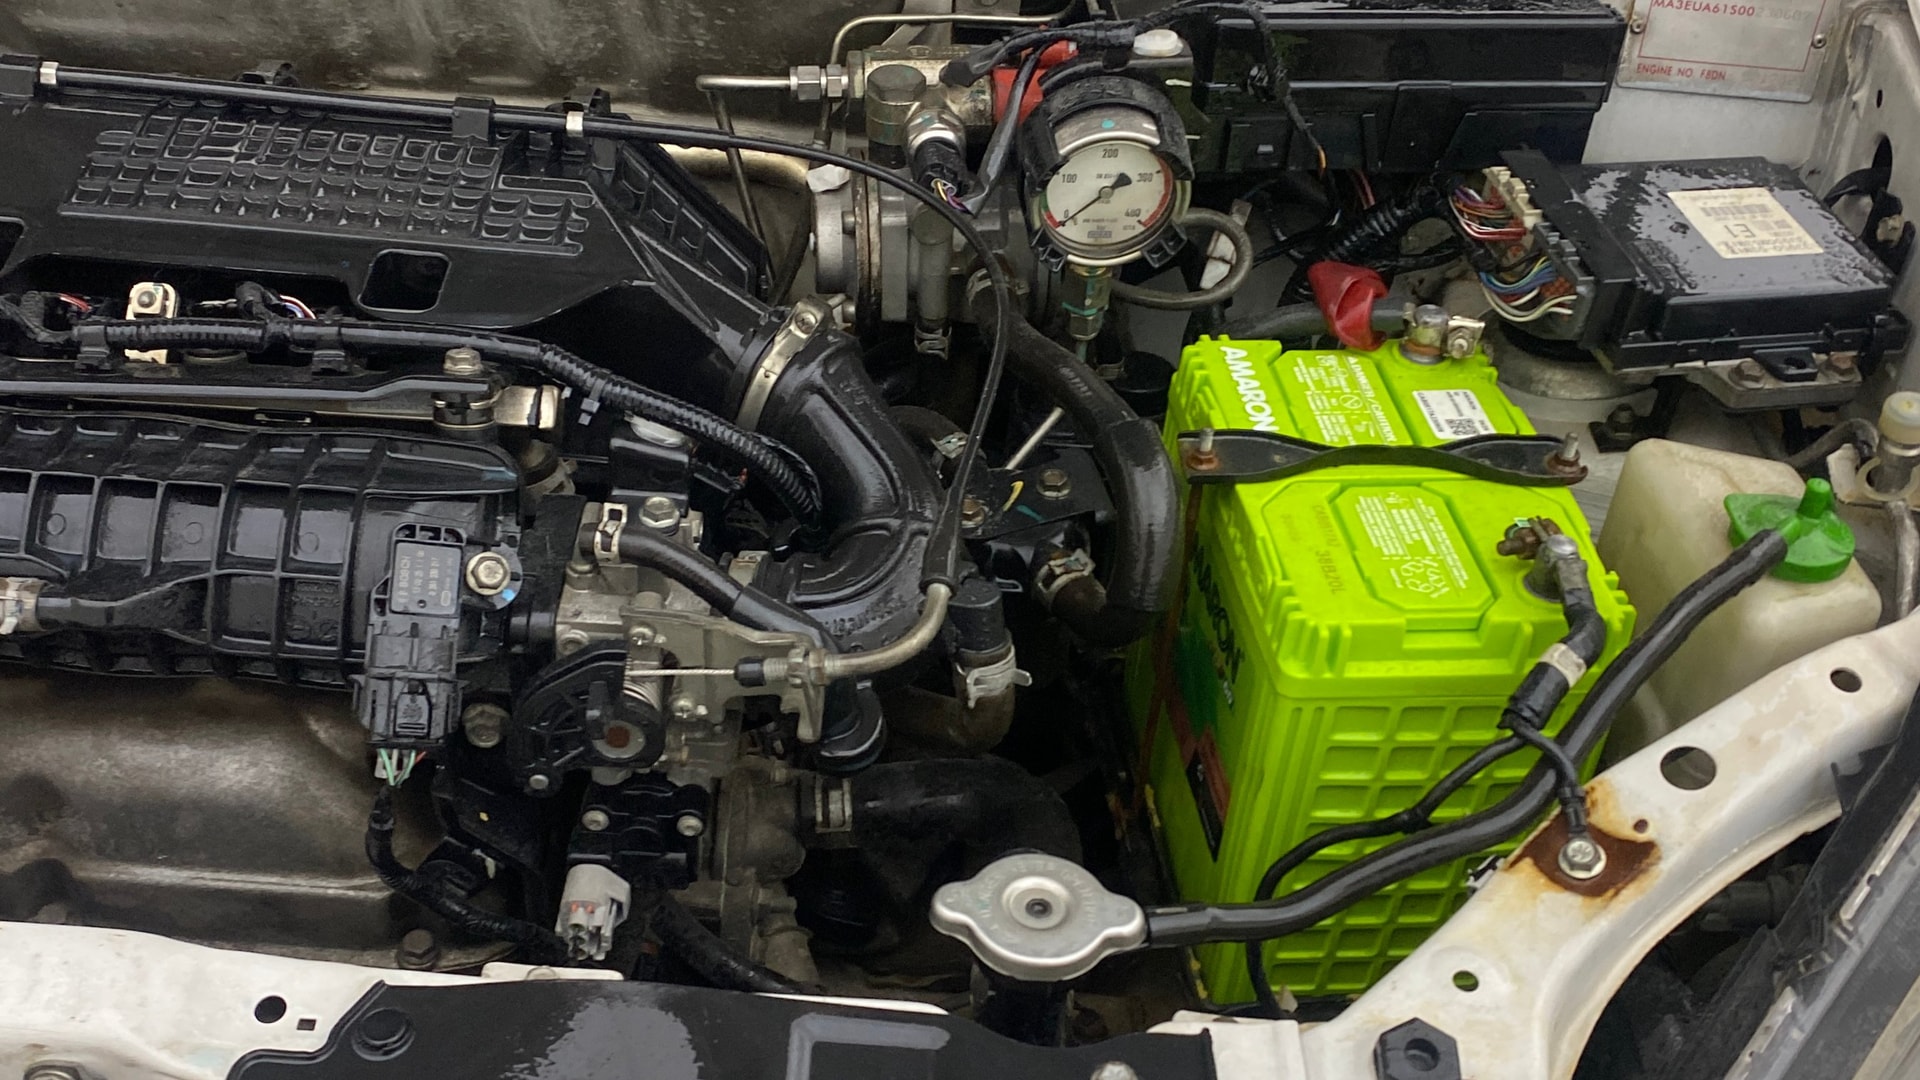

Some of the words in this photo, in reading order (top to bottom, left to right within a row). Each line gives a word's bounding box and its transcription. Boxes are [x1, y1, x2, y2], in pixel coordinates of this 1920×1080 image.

[1636, 63, 1673, 77] ENGINE
[1677, 67, 1693, 78] NO
[1102, 148, 1119, 159] 200
[1062, 173, 1077, 184] 100
[1136, 172, 1153, 183] 300
[1063, 209, 1070, 218] 0
[1124, 208, 1142, 218] 400
[1219, 346, 1280, 432] AMARON
